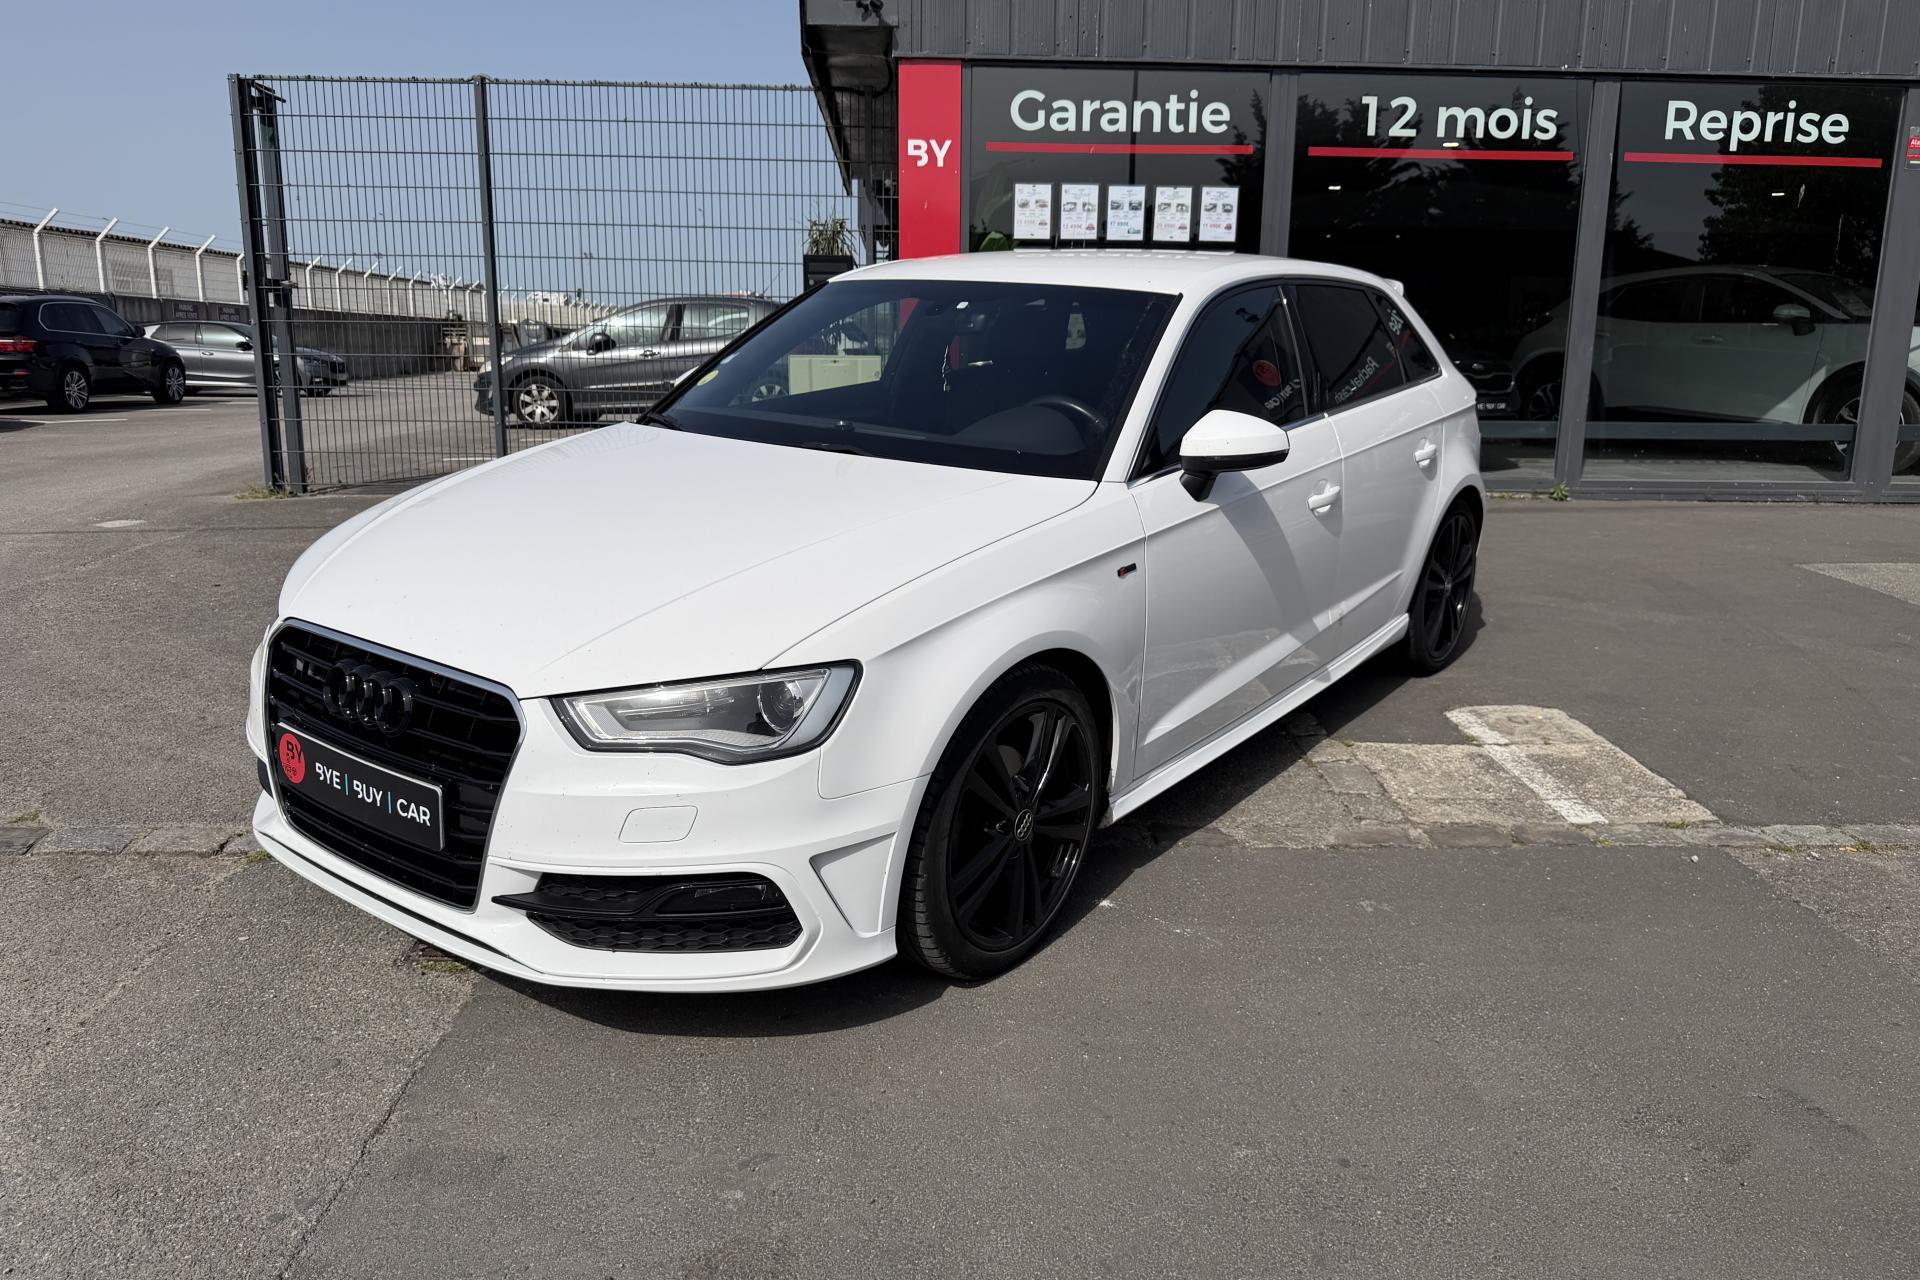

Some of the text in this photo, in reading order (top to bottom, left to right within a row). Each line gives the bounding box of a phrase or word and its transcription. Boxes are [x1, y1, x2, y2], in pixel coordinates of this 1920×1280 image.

[1010, 89, 1231, 134] Garantie
[1361, 95, 1558, 140] 12 mois
[1664, 100, 1849, 152] Reprise
[907, 138, 952, 168] BY
[315, 762, 342, 790] BYE
[353, 780, 384, 806] BUY
[396, 797, 431, 827] CAR
